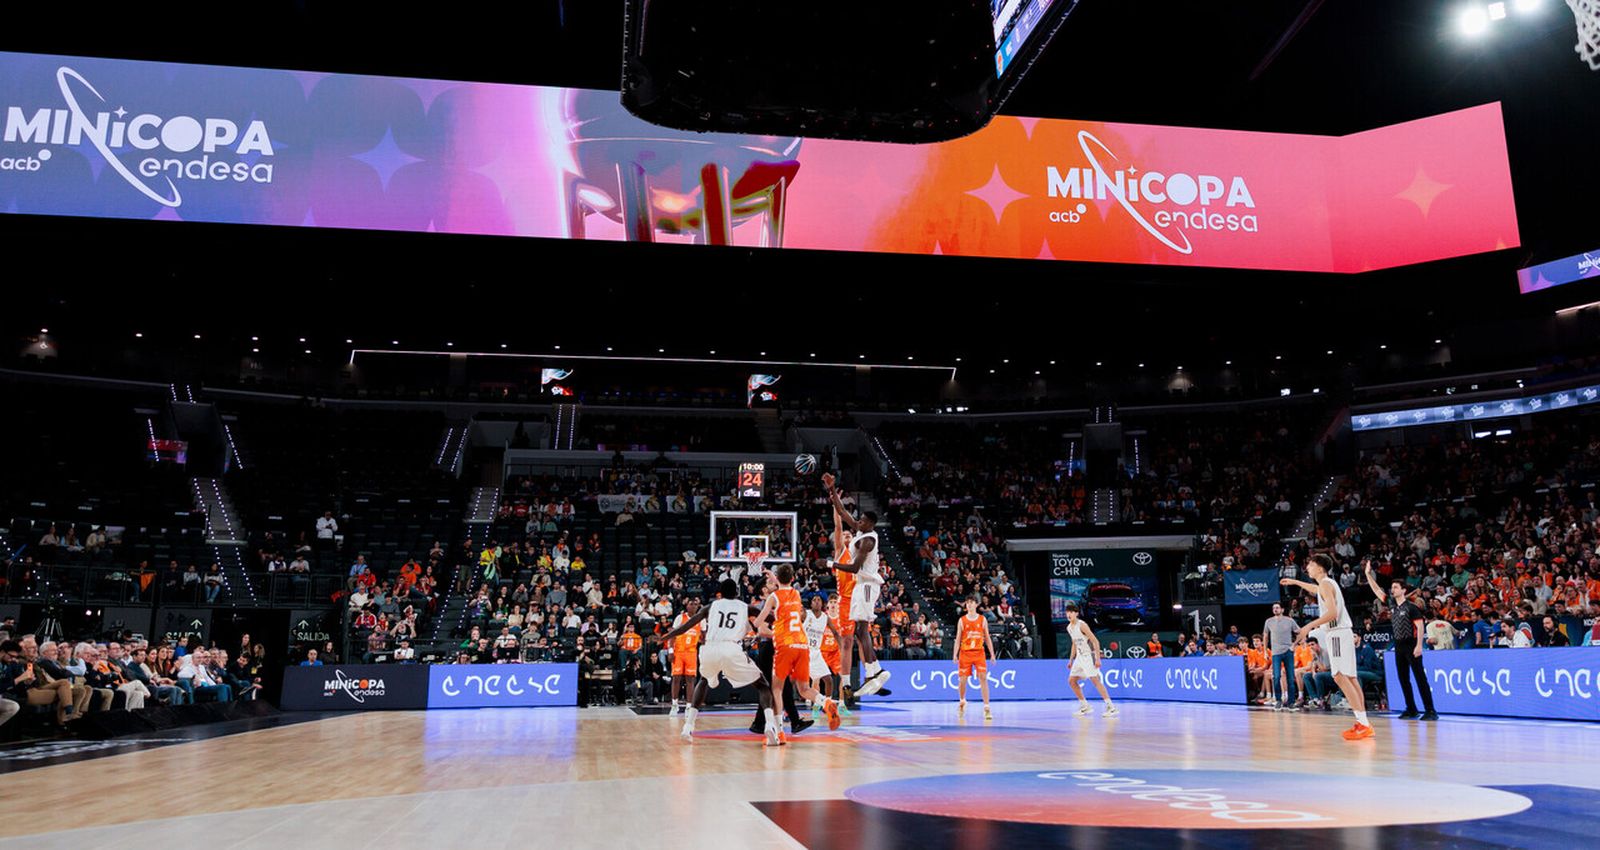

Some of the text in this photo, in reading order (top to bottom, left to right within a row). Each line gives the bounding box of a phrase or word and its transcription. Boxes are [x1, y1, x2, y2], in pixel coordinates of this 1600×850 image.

[139, 155, 273, 184] endesa
[1049, 206, 1082, 224] acb
[1154, 208, 1258, 233] endesa
[742, 463, 764, 471] 10:00
[743, 473, 762, 486] 24
[1053, 558, 1094, 567] TOYOTA
[1053, 567, 1080, 576] C-HR
[718, 610, 738, 629] 16
[789, 611, 801, 632] 2
[1363, 631, 1390, 642] endesa
[1037, 771, 1337, 823] endesa
